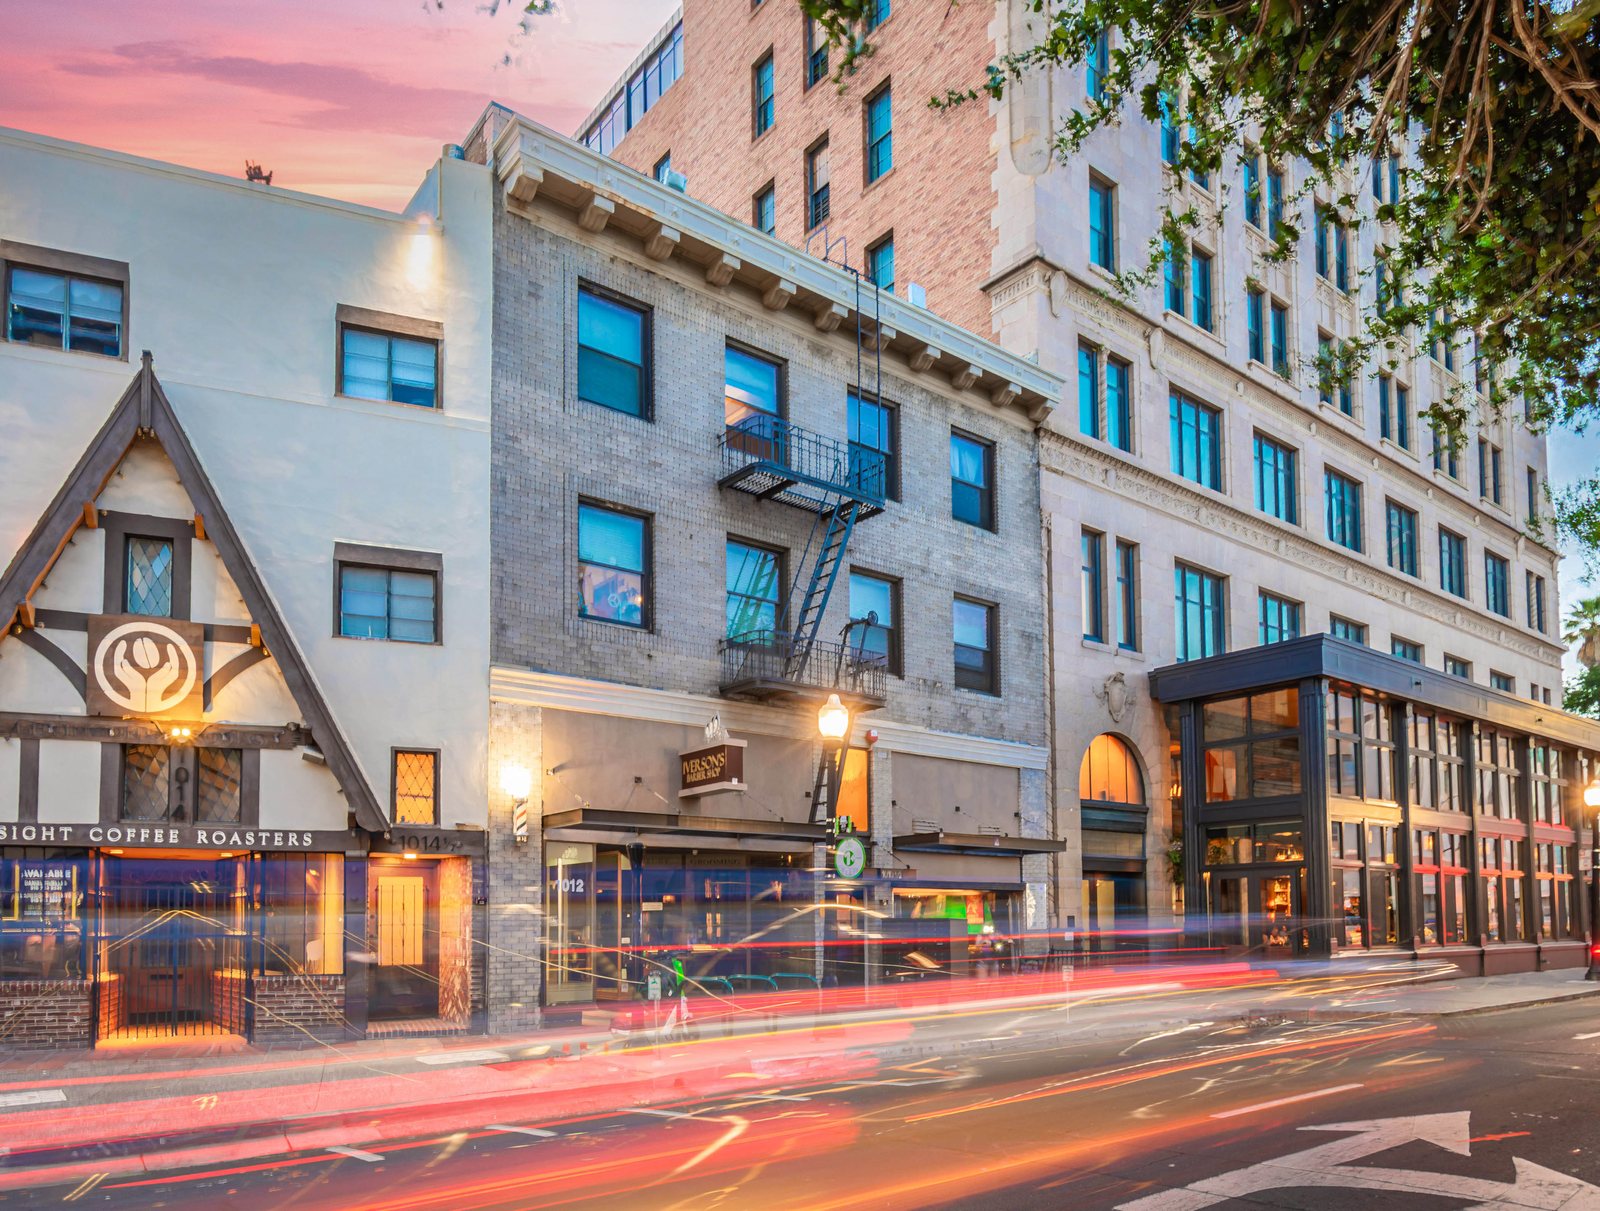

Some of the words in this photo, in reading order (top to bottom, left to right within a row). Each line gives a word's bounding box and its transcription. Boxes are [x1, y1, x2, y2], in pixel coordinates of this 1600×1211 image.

[0, 824, 72, 841] SIGHT
[89, 827, 179, 843] COFFEE
[197, 829, 312, 846] ROASTERS
[399, 835, 440, 851] 1014
